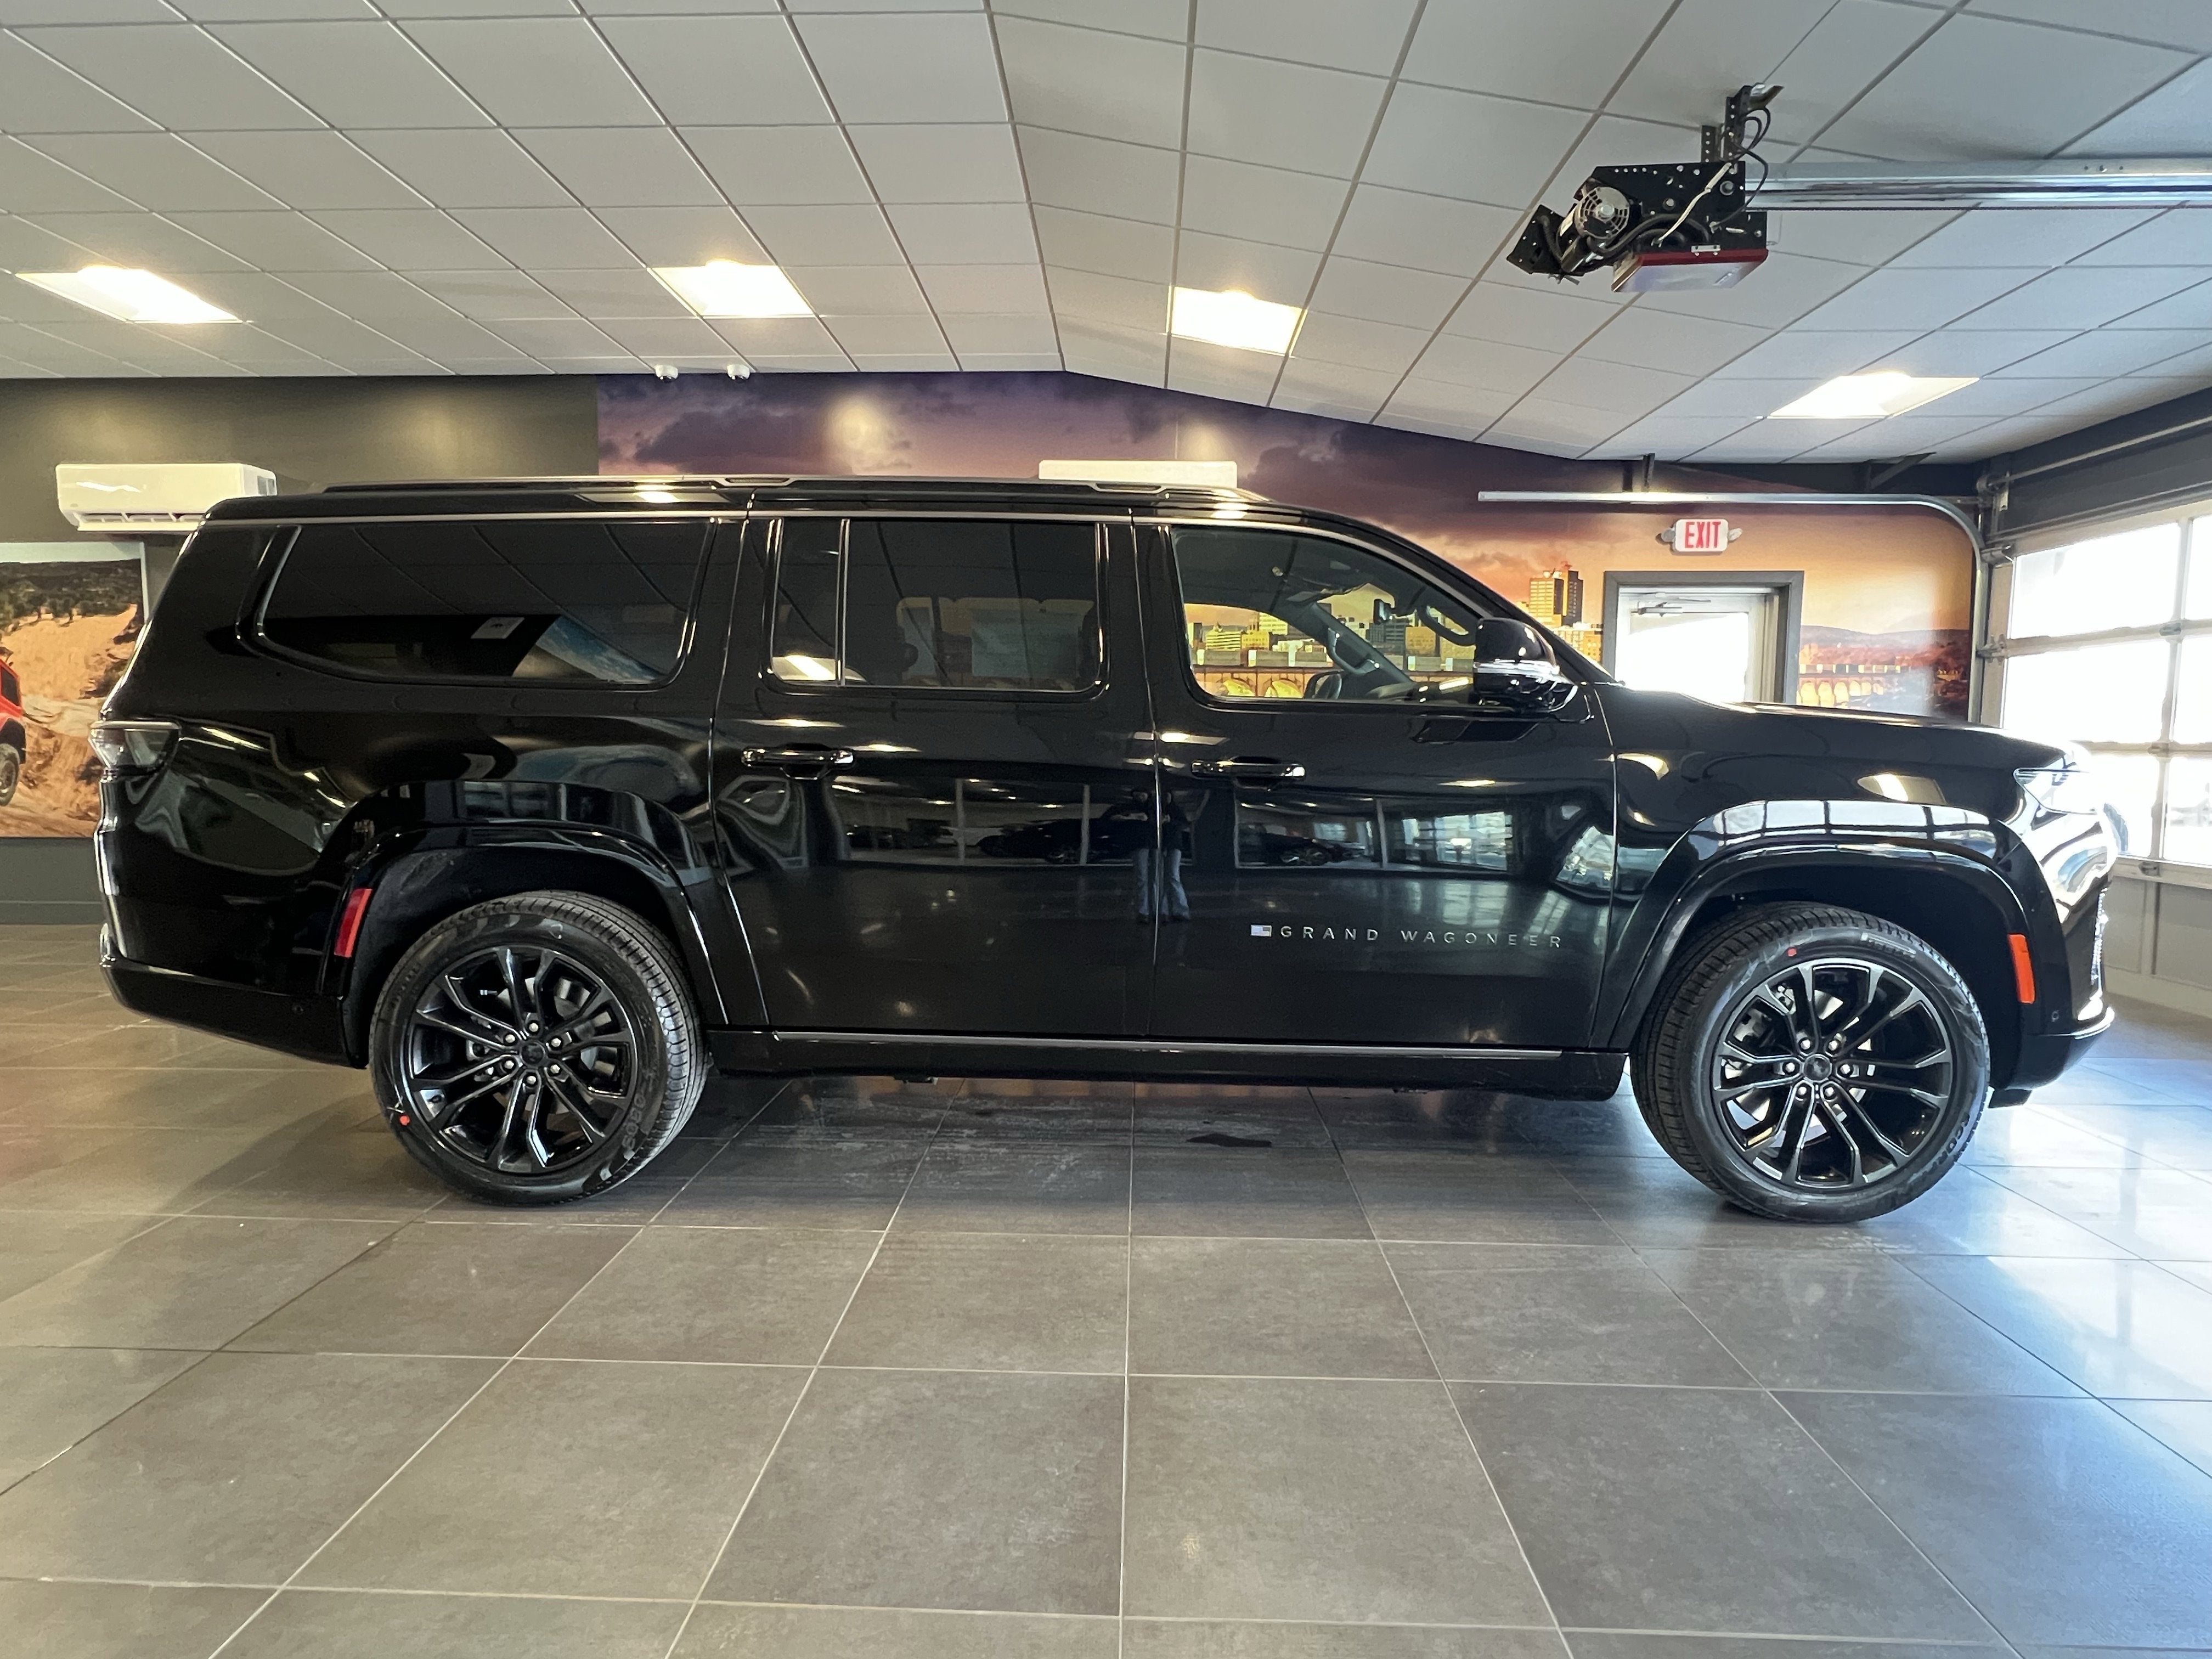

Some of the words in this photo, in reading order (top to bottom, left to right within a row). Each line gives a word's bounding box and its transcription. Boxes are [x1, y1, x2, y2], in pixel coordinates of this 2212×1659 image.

[1685, 521, 1722, 549] EXIT
[1280, 926, 1379, 940] GRAND
[1401, 930, 1560, 948] WAGONEER
